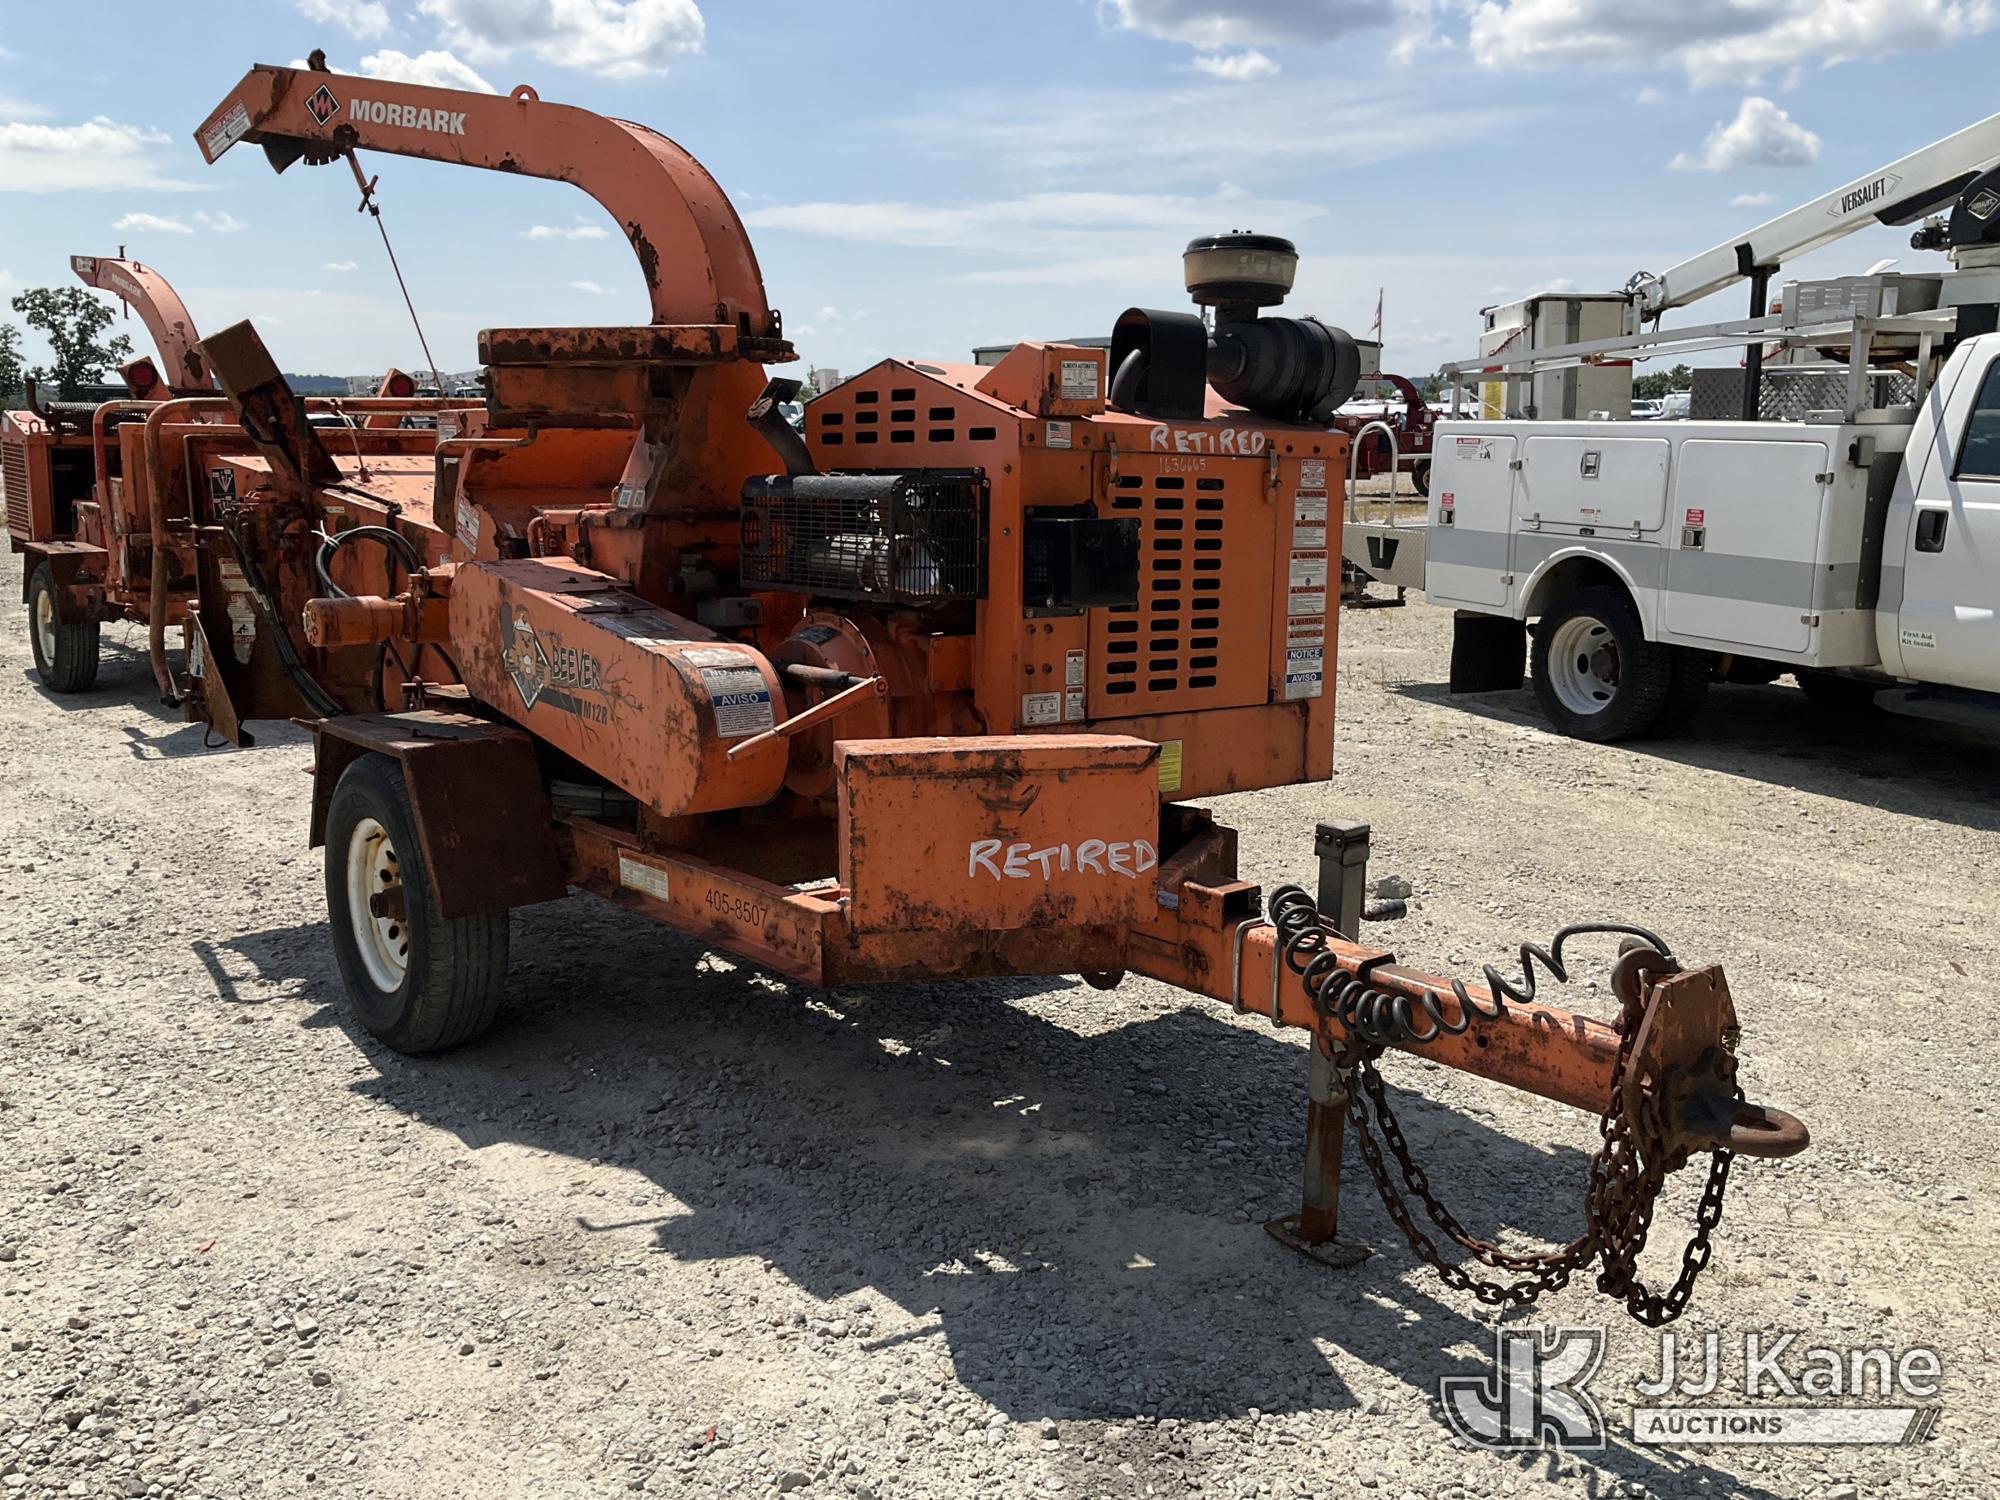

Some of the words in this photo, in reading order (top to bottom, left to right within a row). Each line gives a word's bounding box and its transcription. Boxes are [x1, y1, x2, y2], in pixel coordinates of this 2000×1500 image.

[349, 98, 466, 136] MORBARK
[1841, 177, 1886, 214] VERSALIFT
[1150, 424, 1266, 455] RETIRED
[551, 645, 601, 689] BEEVER
[1290, 649, 1320, 659] NOTICE
[1291, 672, 1317, 682] AVISO
[583, 699, 608, 725] M12R
[721, 693, 759, 706] AVISO
[968, 838, 1159, 882] RETIRED
[705, 888, 768, 929] 405-8507
